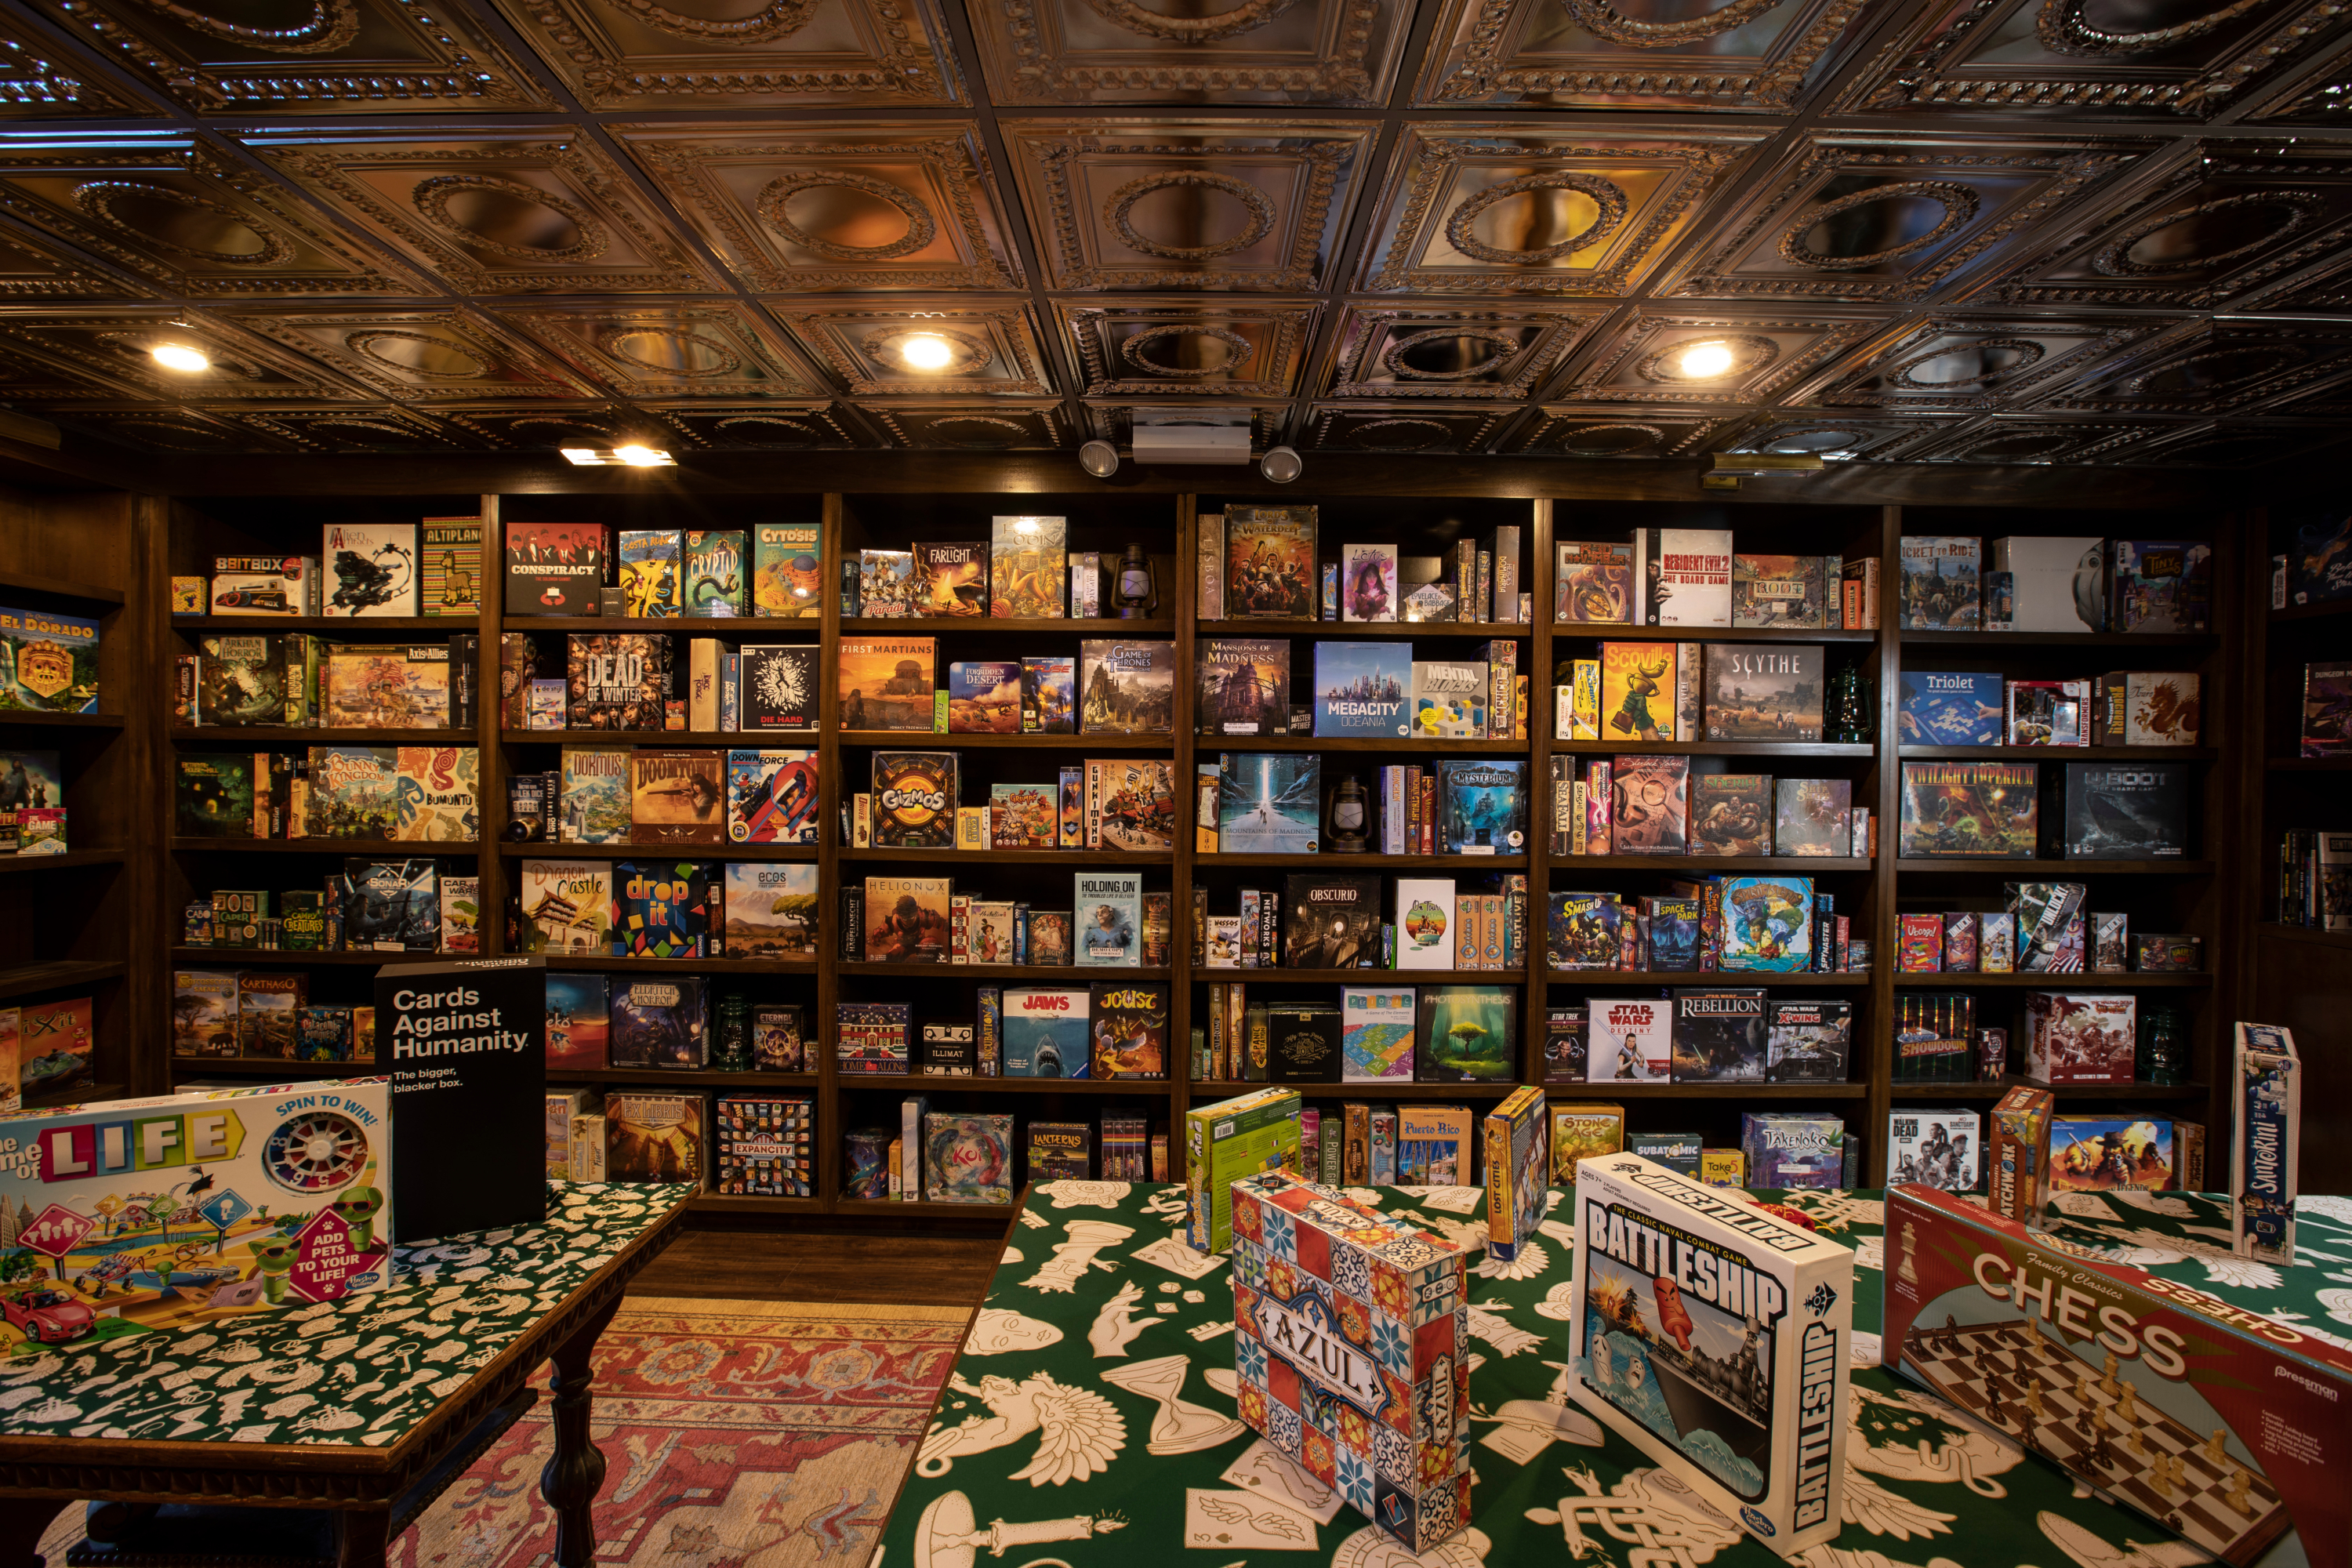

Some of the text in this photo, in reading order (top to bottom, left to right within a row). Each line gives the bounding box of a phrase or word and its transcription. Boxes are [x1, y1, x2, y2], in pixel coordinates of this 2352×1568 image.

[1255, 510, 1288, 521] LORDS
[761, 528, 817, 543] CYTOSIS
[1242, 523, 1302, 535] WATERDEEP
[931, 549, 971, 564] FARLIGHT
[1664, 554, 1730, 572] RESIDENT EVIL 2
[2150, 556, 2174, 569] TINY
[216, 557, 283, 572] 8BITBOX
[511, 564, 597, 576] CONSPIRACY
[691, 550, 739, 581] CRYPTID
[1204, 539, 1216, 596] LISBOA
[1664, 575, 1730, 585] THE BOARD GAME
[1756, 583, 1805, 596] ROOT
[867, 602, 906, 615] Parade
[0, 614, 94, 638] EL DORADO
[223, 637, 267, 649] ARKHAM
[843, 645, 932, 654] FIRST MARTIANS
[1211, 641, 1272, 653] MANSIONS OF
[223, 648, 263, 660] HORROR
[1207, 652, 1275, 664] MADNESS
[1606, 646, 1674, 668] Scoville
[588, 654, 643, 687] DEAD
[1427, 664, 1479, 682] MENTAL
[1733, 654, 1800, 680] SCYTHE
[966, 675, 1005, 684] DESERT
[1421, 677, 1480, 693] BLOCKS
[1927, 674, 1973, 690] Triolet
[588, 688, 642, 702] OF WINTER
[1328, 702, 1399, 717] MEGACITY
[1341, 716, 1386, 728] OCEANIA
[2080, 697, 2089, 746] TRANSFORMERS
[574, 753, 622, 779] DOKMUS
[1458, 772, 1511, 783] MYSTERIUM
[1910, 768, 2035, 785] TWILIGHT IMPERIUM
[28, 820, 56, 830] GAME
[662, 836, 692, 844] RELOADED
[370, 877, 408, 890] SONAR
[758, 870, 786, 884] ecos
[627, 874, 688, 906] drop
[869, 881, 946, 891] HELIONOX
[1082, 880, 1135, 893] HOLDING ON
[1310, 889, 1356, 902] OBSCURIO
[186, 909, 211, 920] CABO
[650, 901, 668, 926] it
[1661, 904, 1686, 915] SPACE
[1677, 909, 1699, 921] PARK
[220, 912, 249, 923] CAPER
[284, 917, 324, 932] CREATURES
[1908, 925, 1936, 938] Ubongo!
[241, 978, 296, 989] CARTHAGO
[634, 985, 676, 996] ELDRITCH
[394, 986, 479, 1011] Cards
[637, 995, 673, 1005] HORROR
[1022, 996, 1070, 1011] JAWS
[1101, 989, 1159, 1010] JOUST
[1425, 994, 1512, 1004] PHOTOSYNTHESIS
[1611, 1004, 1654, 1015] STAR
[1681, 998, 1762, 1017] REBELLION
[393, 1008, 502, 1038] Against
[760, 1013, 793, 1022] ETERNAL
[1608, 1014, 1654, 1025] WARS
[1778, 1013, 1820, 1024] X-WING
[984, 1009, 994, 1061] INCUBATION
[394, 1030, 529, 1059] Humanity.
[1900, 1039, 1967, 1057] SHOWDOWN
[932, 1050, 964, 1058] ILLIMAT
[394, 1068, 456, 1080] The bigger,
[394, 1079, 463, 1093] blacker box.
[276, 1094, 379, 1127] SPIN TO WIN!
[1404, 1122, 1460, 1135] Puerto Rico
[1563, 1117, 1610, 1129] STONE
[1893, 1118, 1918, 1127] WALKING
[1571, 1127, 1603, 1138] AGE
[1893, 1126, 1918, 1138] DEAD
[52, 1115, 226, 1176] LIFE
[1033, 1134, 1081, 1146] LANTERNS
[1763, 1129, 1830, 1151] TAKENOKO
[735, 1144, 792, 1155] EXPANCITY
[16, 1160, 40, 1180] of
[1581, 1169, 1602, 1184] AGES 7+
[2001, 1142, 2016, 1219] ATCHWORK
[1606, 1183, 1621, 1193] PLAYERS
[1192, 1164, 1204, 1247] Kingdomino
[1602, 1186, 1651, 1214] ADULT ASSEMBLY REQUIRED
[314, 1232, 344, 1247] ADD
[1613, 1204, 1748, 1267] THE CLASSIC NAVAL COMBAT GAME
[311, 1244, 347, 1258] PETS
[297, 1254, 360, 1273] TO YOUR
[1588, 1203, 1783, 1333] BATTLESHIP
[312, 1267, 346, 1283] LIFE!
[347, 1271, 380, 1284] Hasbro
[2026, 1252, 2124, 1301] Family Classics
[1973, 1253, 2187, 1378] CHESS
[2141, 1279, 2304, 1344] CHESS
[1274, 1312, 1367, 1394] AZUL
[1433, 1368, 1450, 1431] AZUL
[1795, 1329, 1836, 1530] BATTLESHIP
[1743, 1506, 1774, 1534] Hasbro
